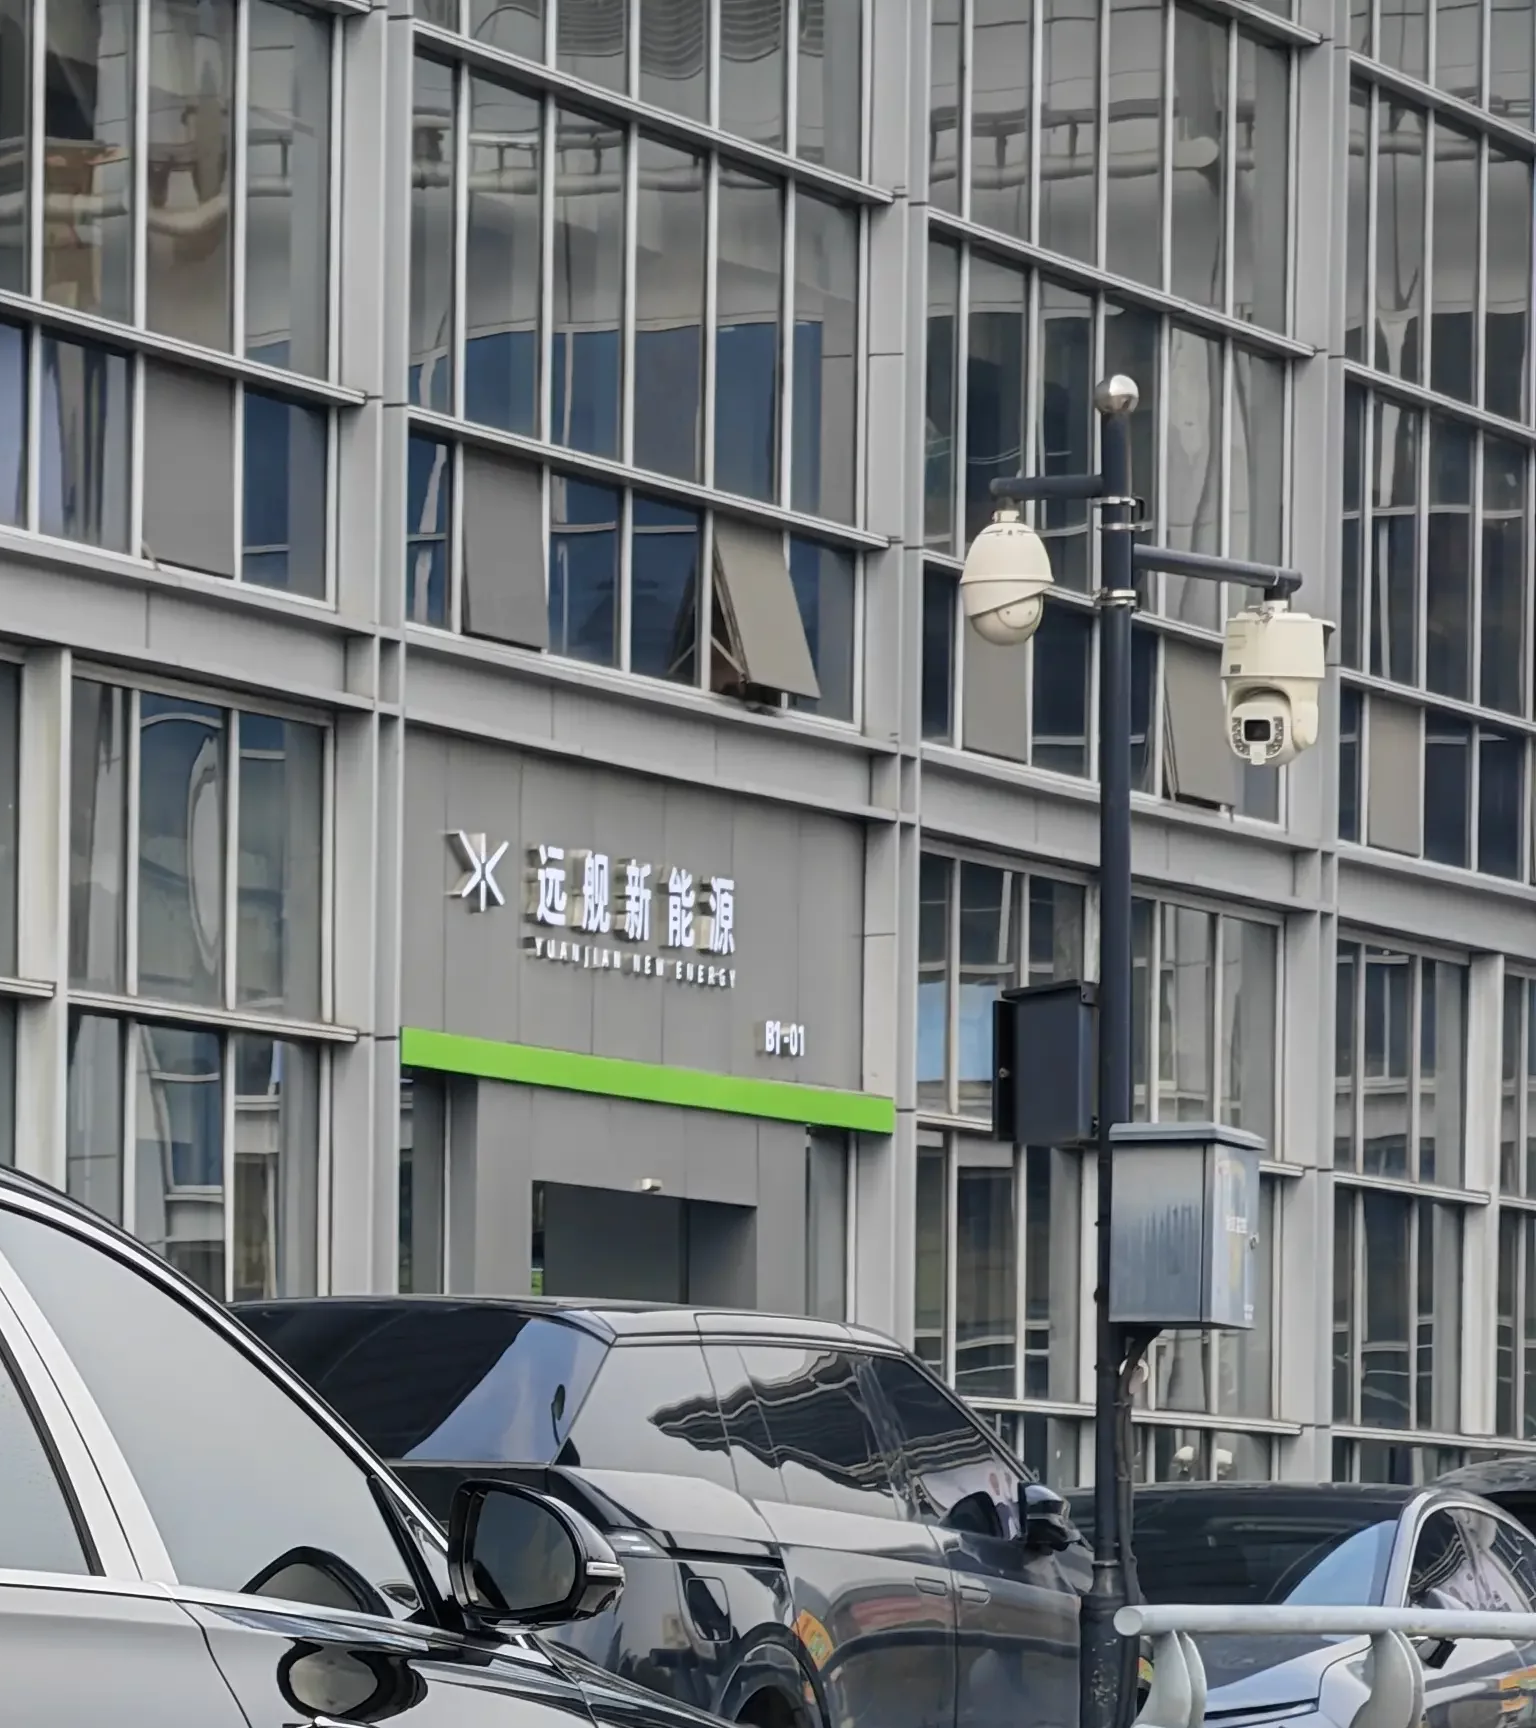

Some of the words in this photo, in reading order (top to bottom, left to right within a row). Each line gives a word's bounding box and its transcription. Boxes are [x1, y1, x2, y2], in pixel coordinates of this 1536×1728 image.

[536, 844, 736, 956] 远舰新能源
[535, 936, 622, 969] YUANJIAN
[633, 954, 665, 977] NEW
[676, 960, 736, 989] ENERGY
[765, 1020, 805, 1057] B1-01
